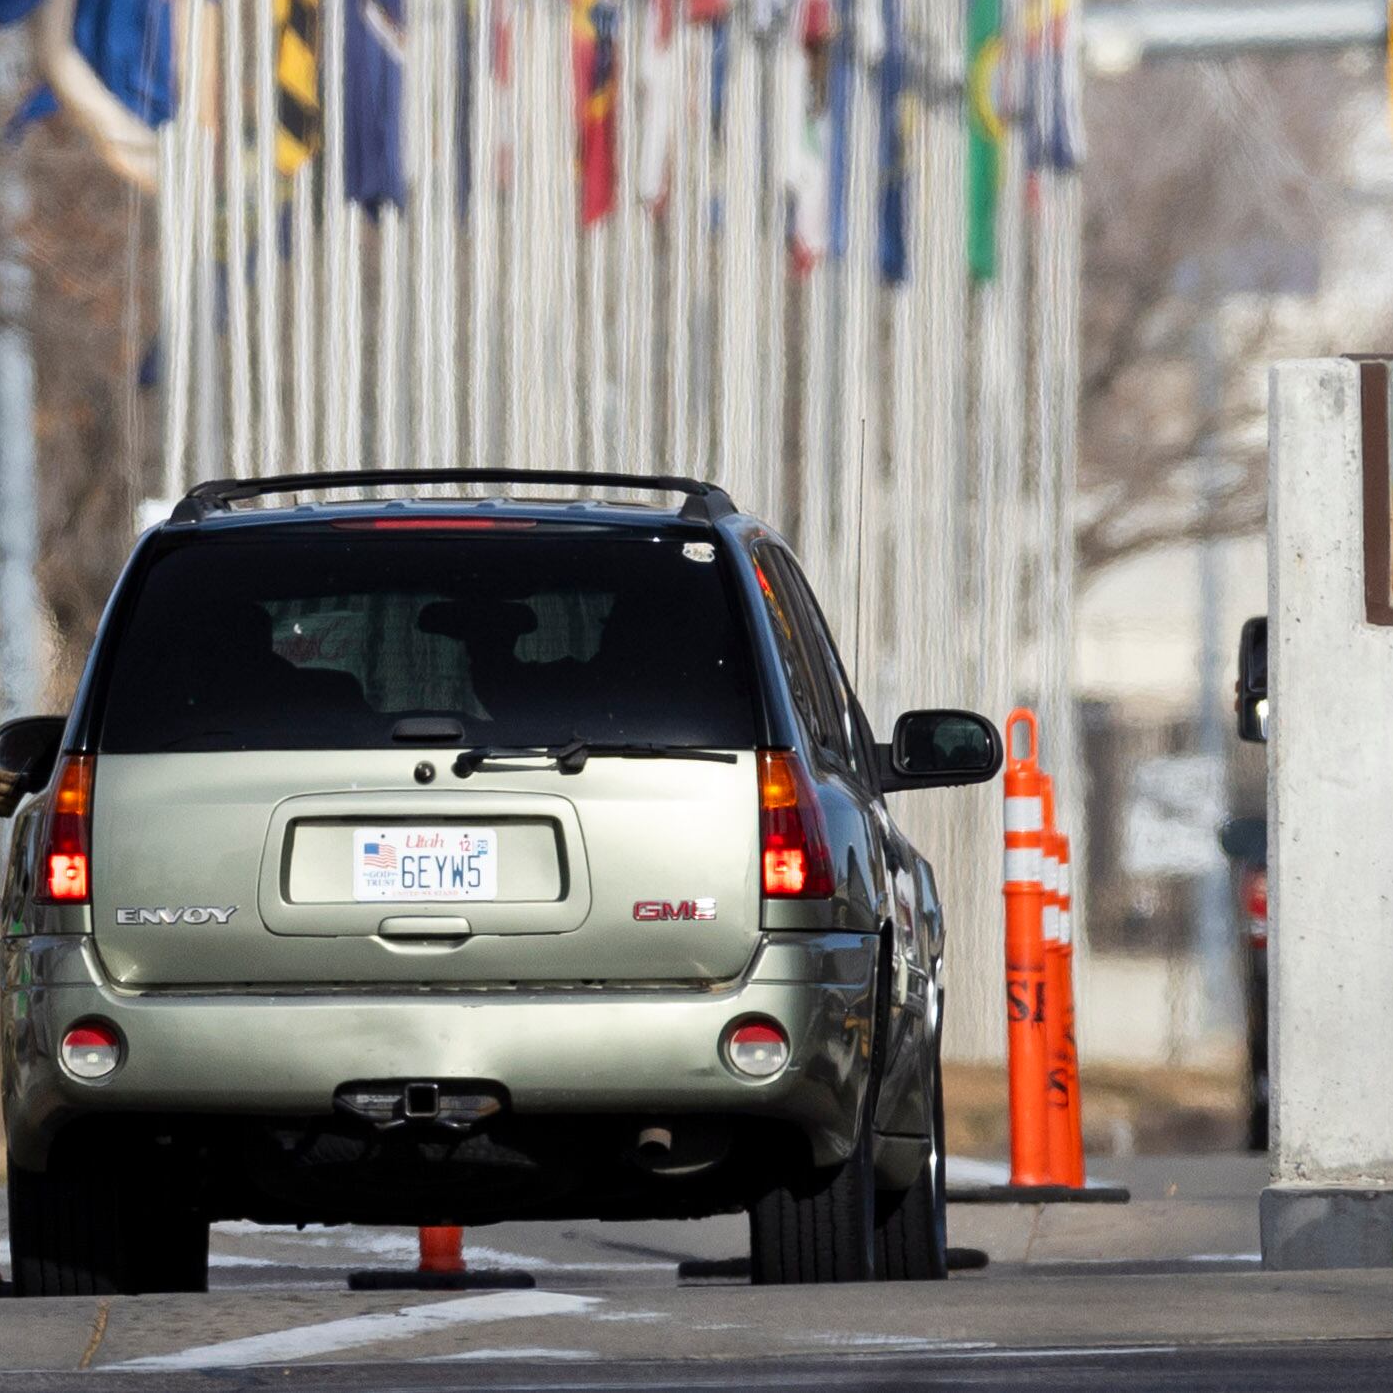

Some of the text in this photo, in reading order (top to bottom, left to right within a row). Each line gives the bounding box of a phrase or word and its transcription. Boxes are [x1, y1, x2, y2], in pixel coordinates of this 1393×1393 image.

[406, 833, 444, 848] Utah
[402, 855, 480, 888] 6EYW5
[367, 879, 395, 887] TRUST
[117, 907, 237, 925] ENVOY
[633, 899, 716, 920] GMC
